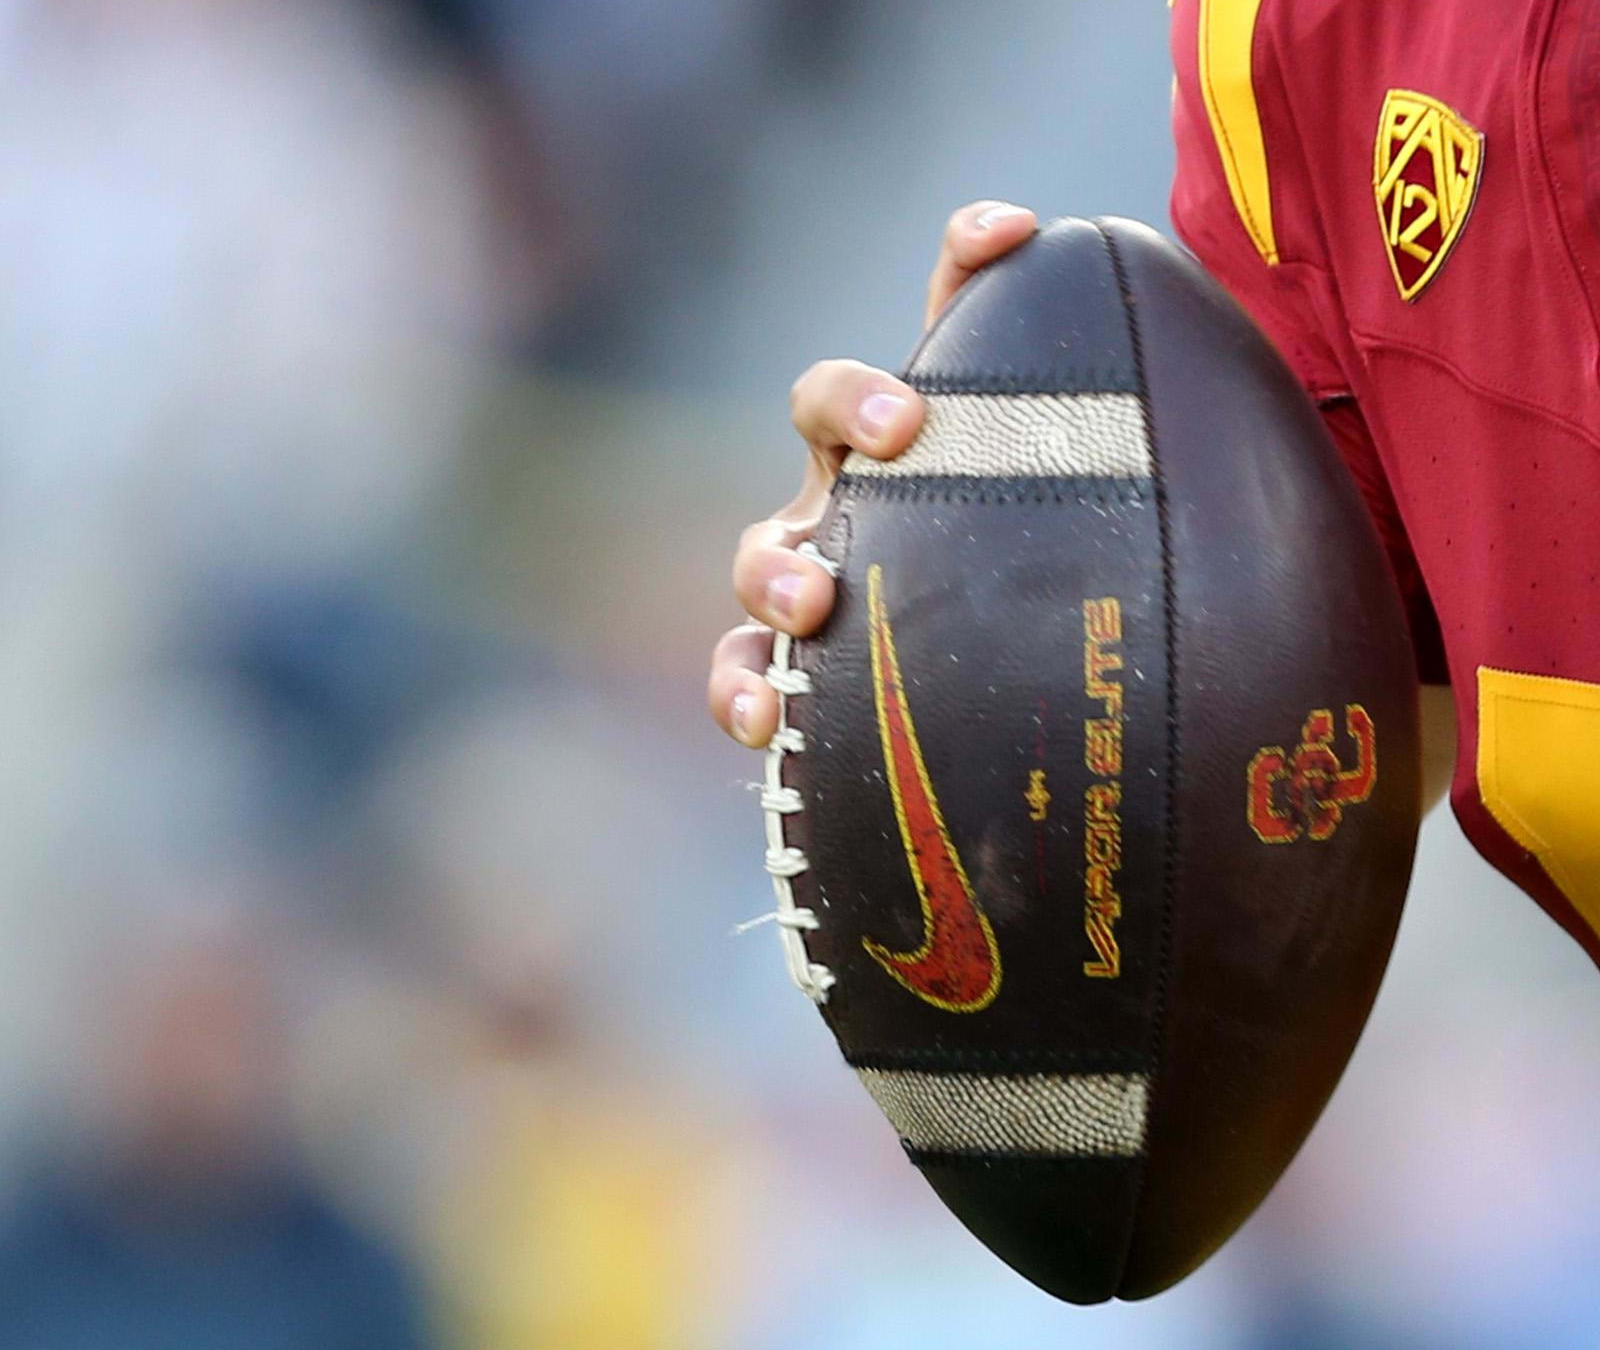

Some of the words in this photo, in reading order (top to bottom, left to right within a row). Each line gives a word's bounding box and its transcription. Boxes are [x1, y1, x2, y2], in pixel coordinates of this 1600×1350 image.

[1379, 97, 1473, 238] PAC
[1390, 179, 1438, 263] 12
[1246, 704, 1377, 845] SC
